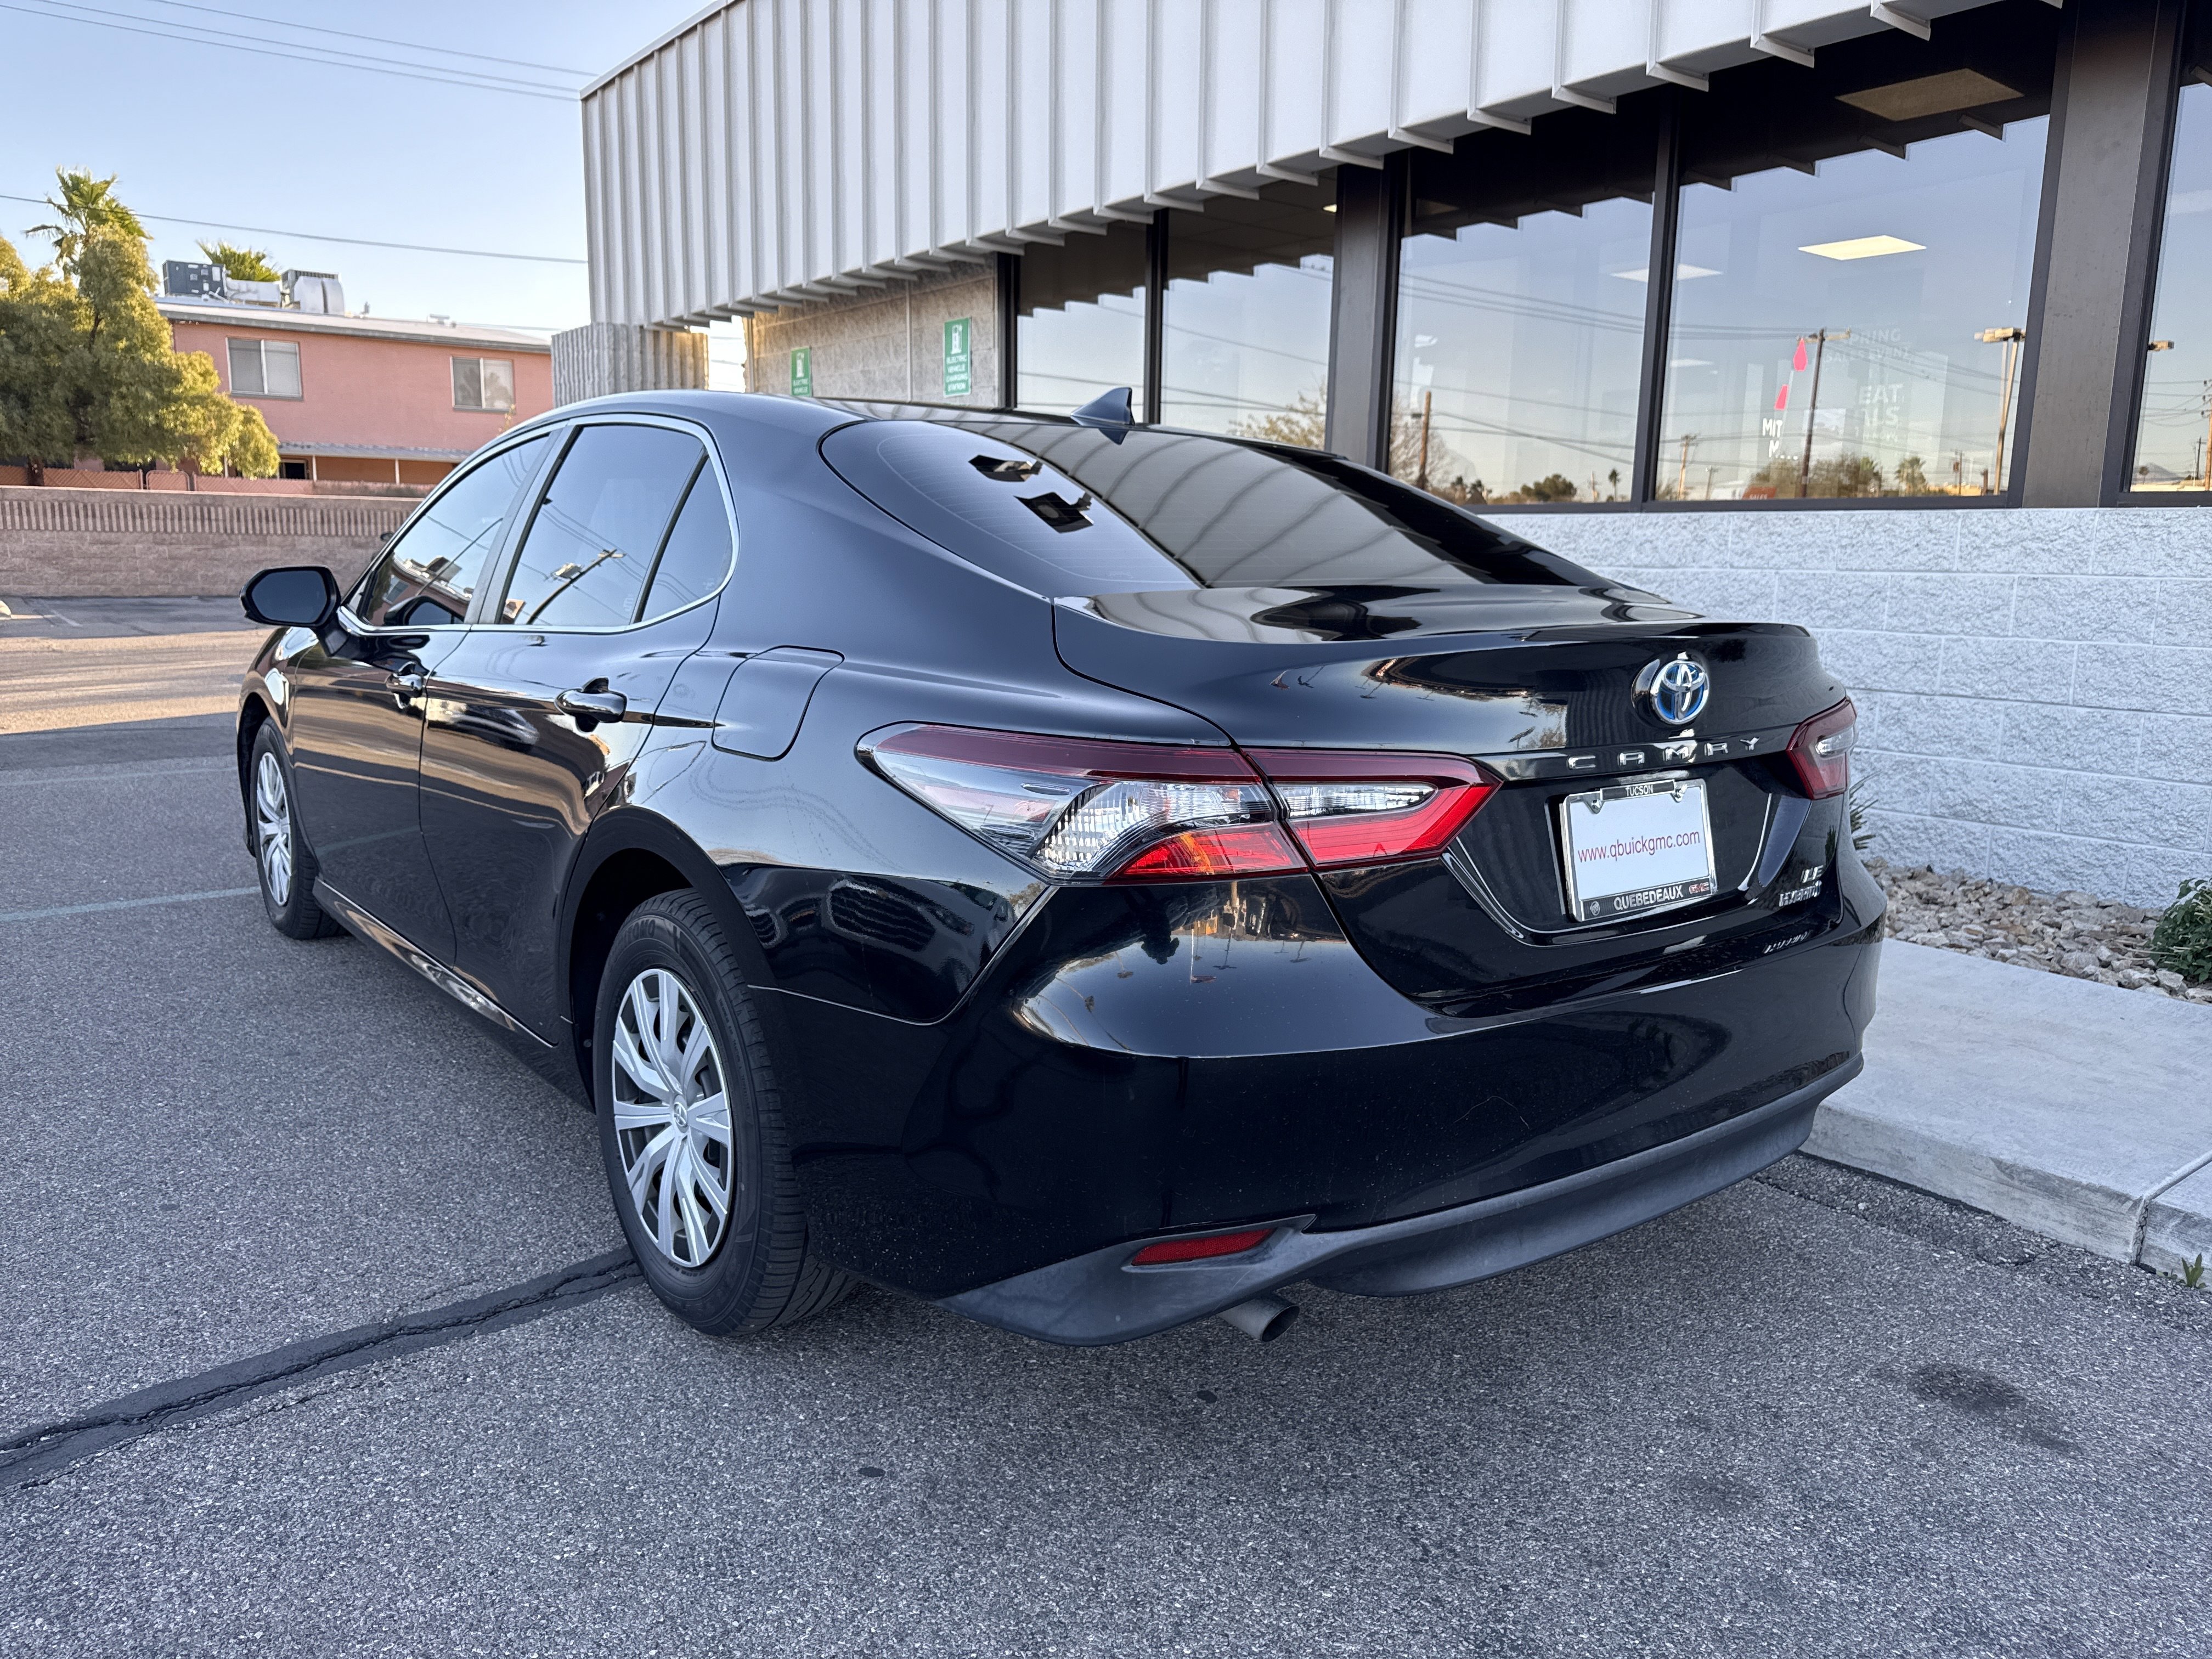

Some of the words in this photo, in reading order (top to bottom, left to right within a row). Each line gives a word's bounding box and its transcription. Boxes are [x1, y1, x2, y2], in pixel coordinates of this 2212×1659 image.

[1566, 737, 1760, 771] CAMRY
[1625, 785, 1654, 797] TUCSON
[1578, 831, 1700, 863] www.qbuickgmc.com
[1613, 884, 1684, 911] QUEBEDEAUX
[1689, 882, 1709, 894] GMC
